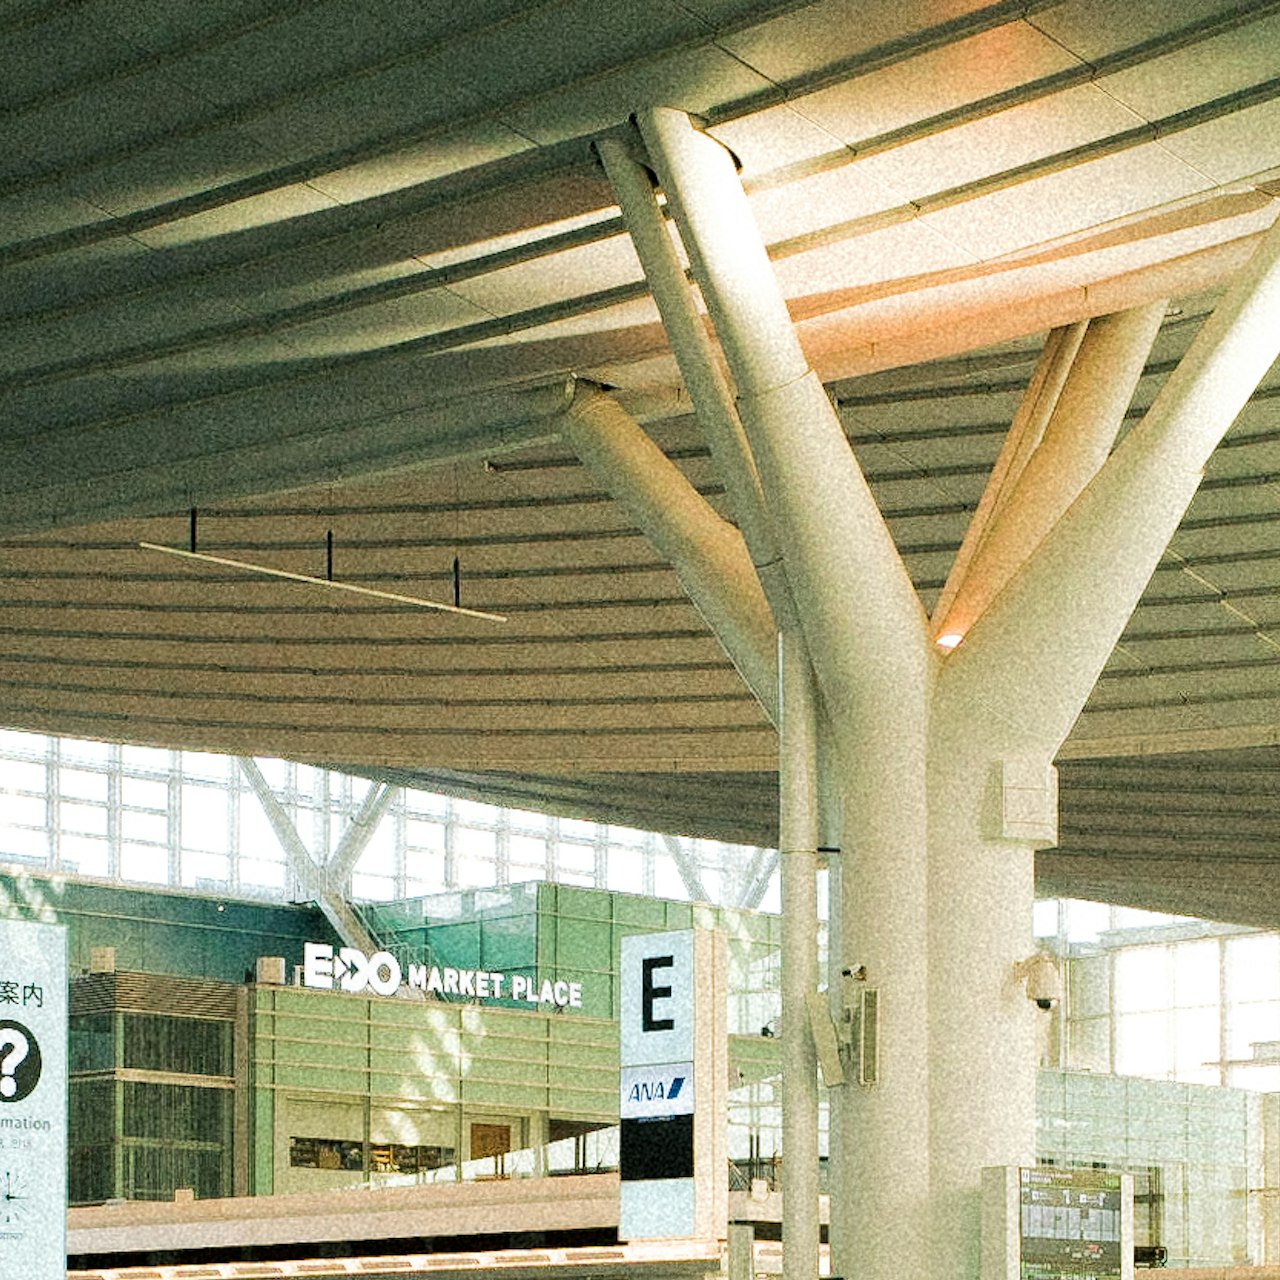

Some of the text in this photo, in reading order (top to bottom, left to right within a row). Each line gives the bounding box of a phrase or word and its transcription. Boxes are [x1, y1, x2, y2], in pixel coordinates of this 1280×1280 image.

[408, 964, 506, 999] MARKET
[511, 974, 583, 1008] PLACE
[641, 955, 675, 1033] E
[628, 1081, 665, 1103] ANA
